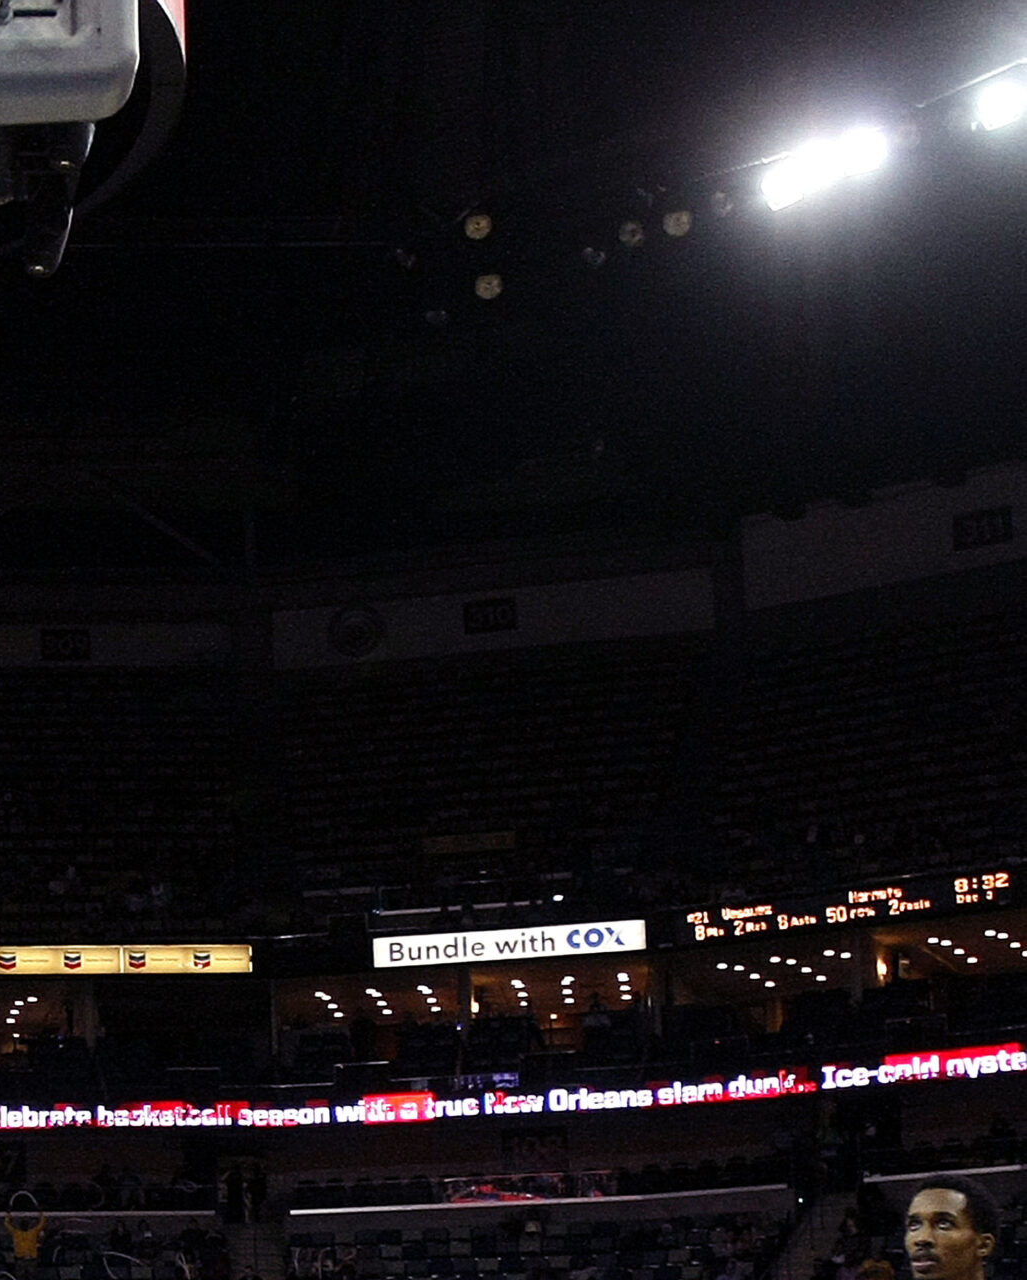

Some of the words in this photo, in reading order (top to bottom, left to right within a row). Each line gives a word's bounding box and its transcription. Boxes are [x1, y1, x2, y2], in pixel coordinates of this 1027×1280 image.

[953, 873, 1009, 892] 8:32
[389, 936, 486, 962] Bundle
[495, 931, 556, 954] with
[566, 927, 625, 949] COX
[822, 1056, 940, 1089] Ice-cold
[98, 1104, 232, 1127] basketball
[239, 1107, 330, 1126] season
[548, 1088, 653, 1112] Orleans
[657, 1082, 723, 1104] slam
